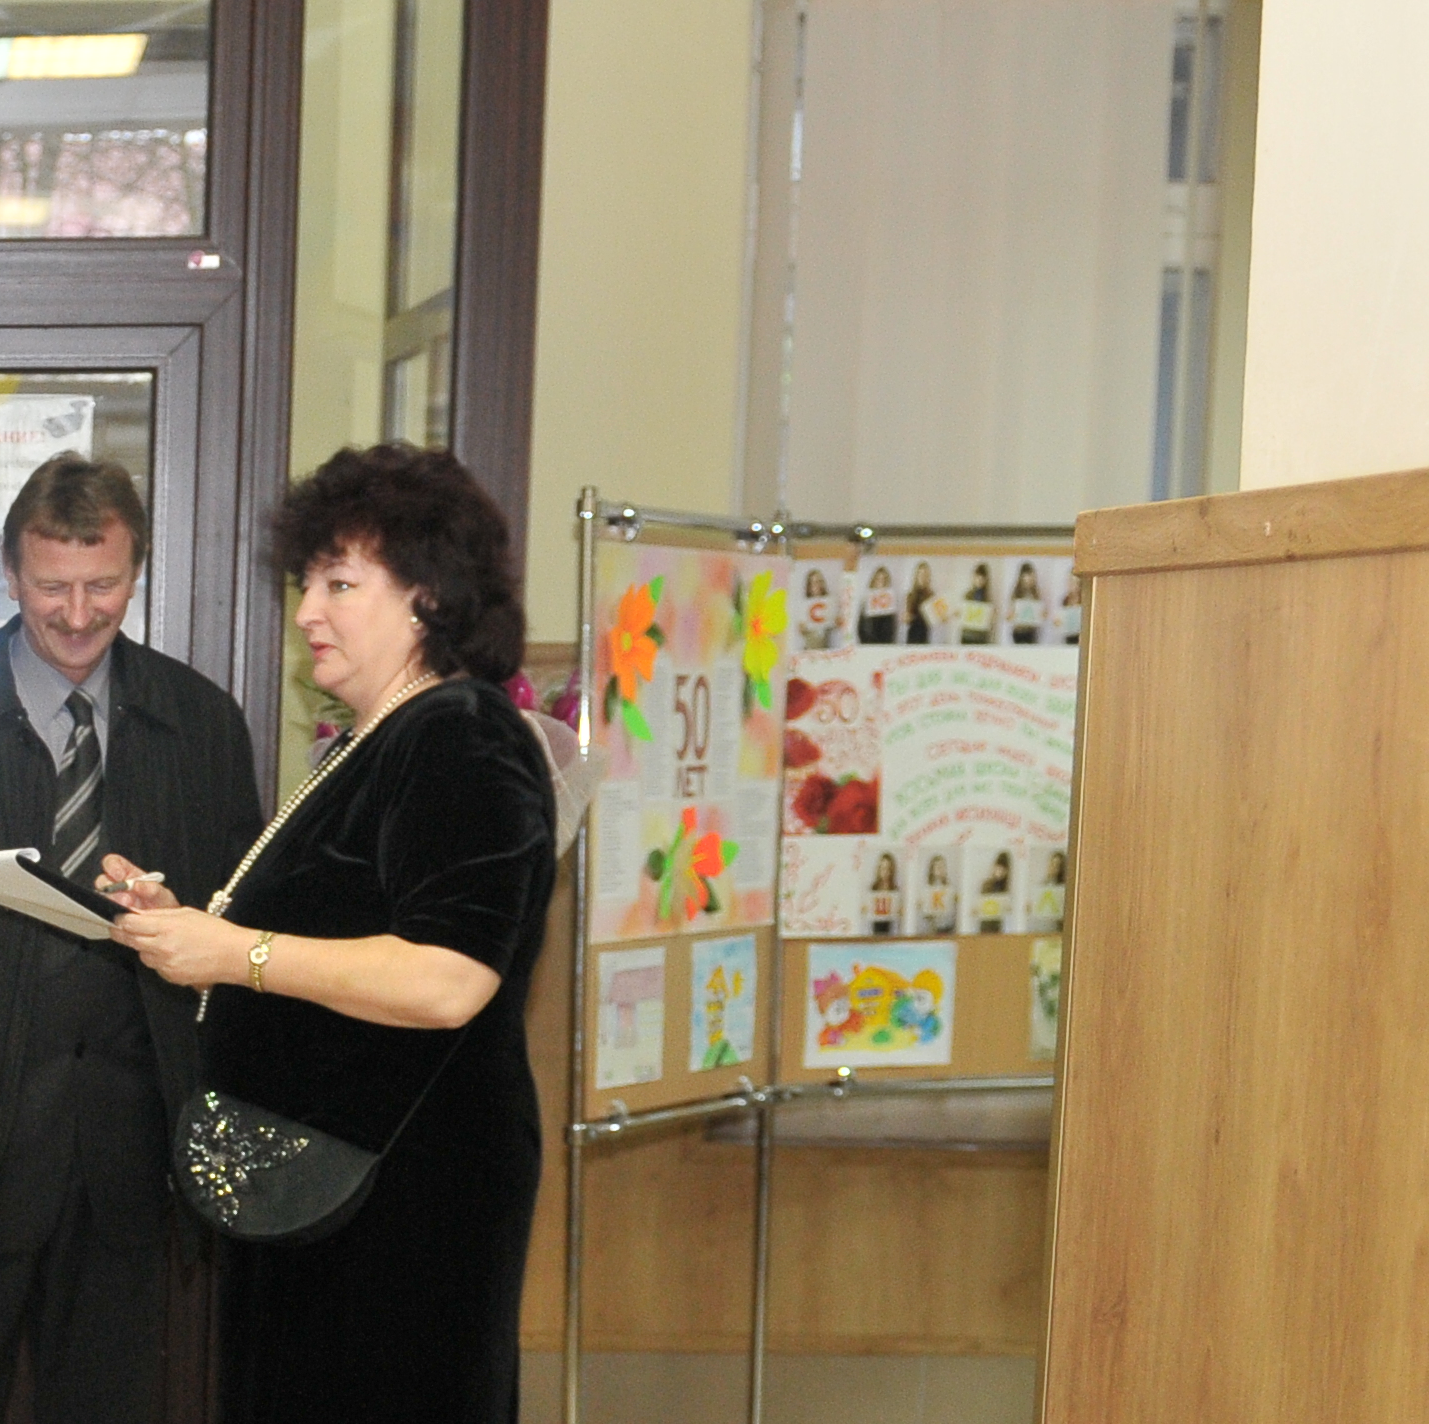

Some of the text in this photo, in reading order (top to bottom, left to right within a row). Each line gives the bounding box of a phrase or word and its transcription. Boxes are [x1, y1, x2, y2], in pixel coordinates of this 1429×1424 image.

[809, 603, 827, 623] С
[675, 675, 711, 760] 50
[816, 680, 860, 725] 50
[675, 764, 708, 797] ЛЕТ
[932, 890, 945, 910] К
